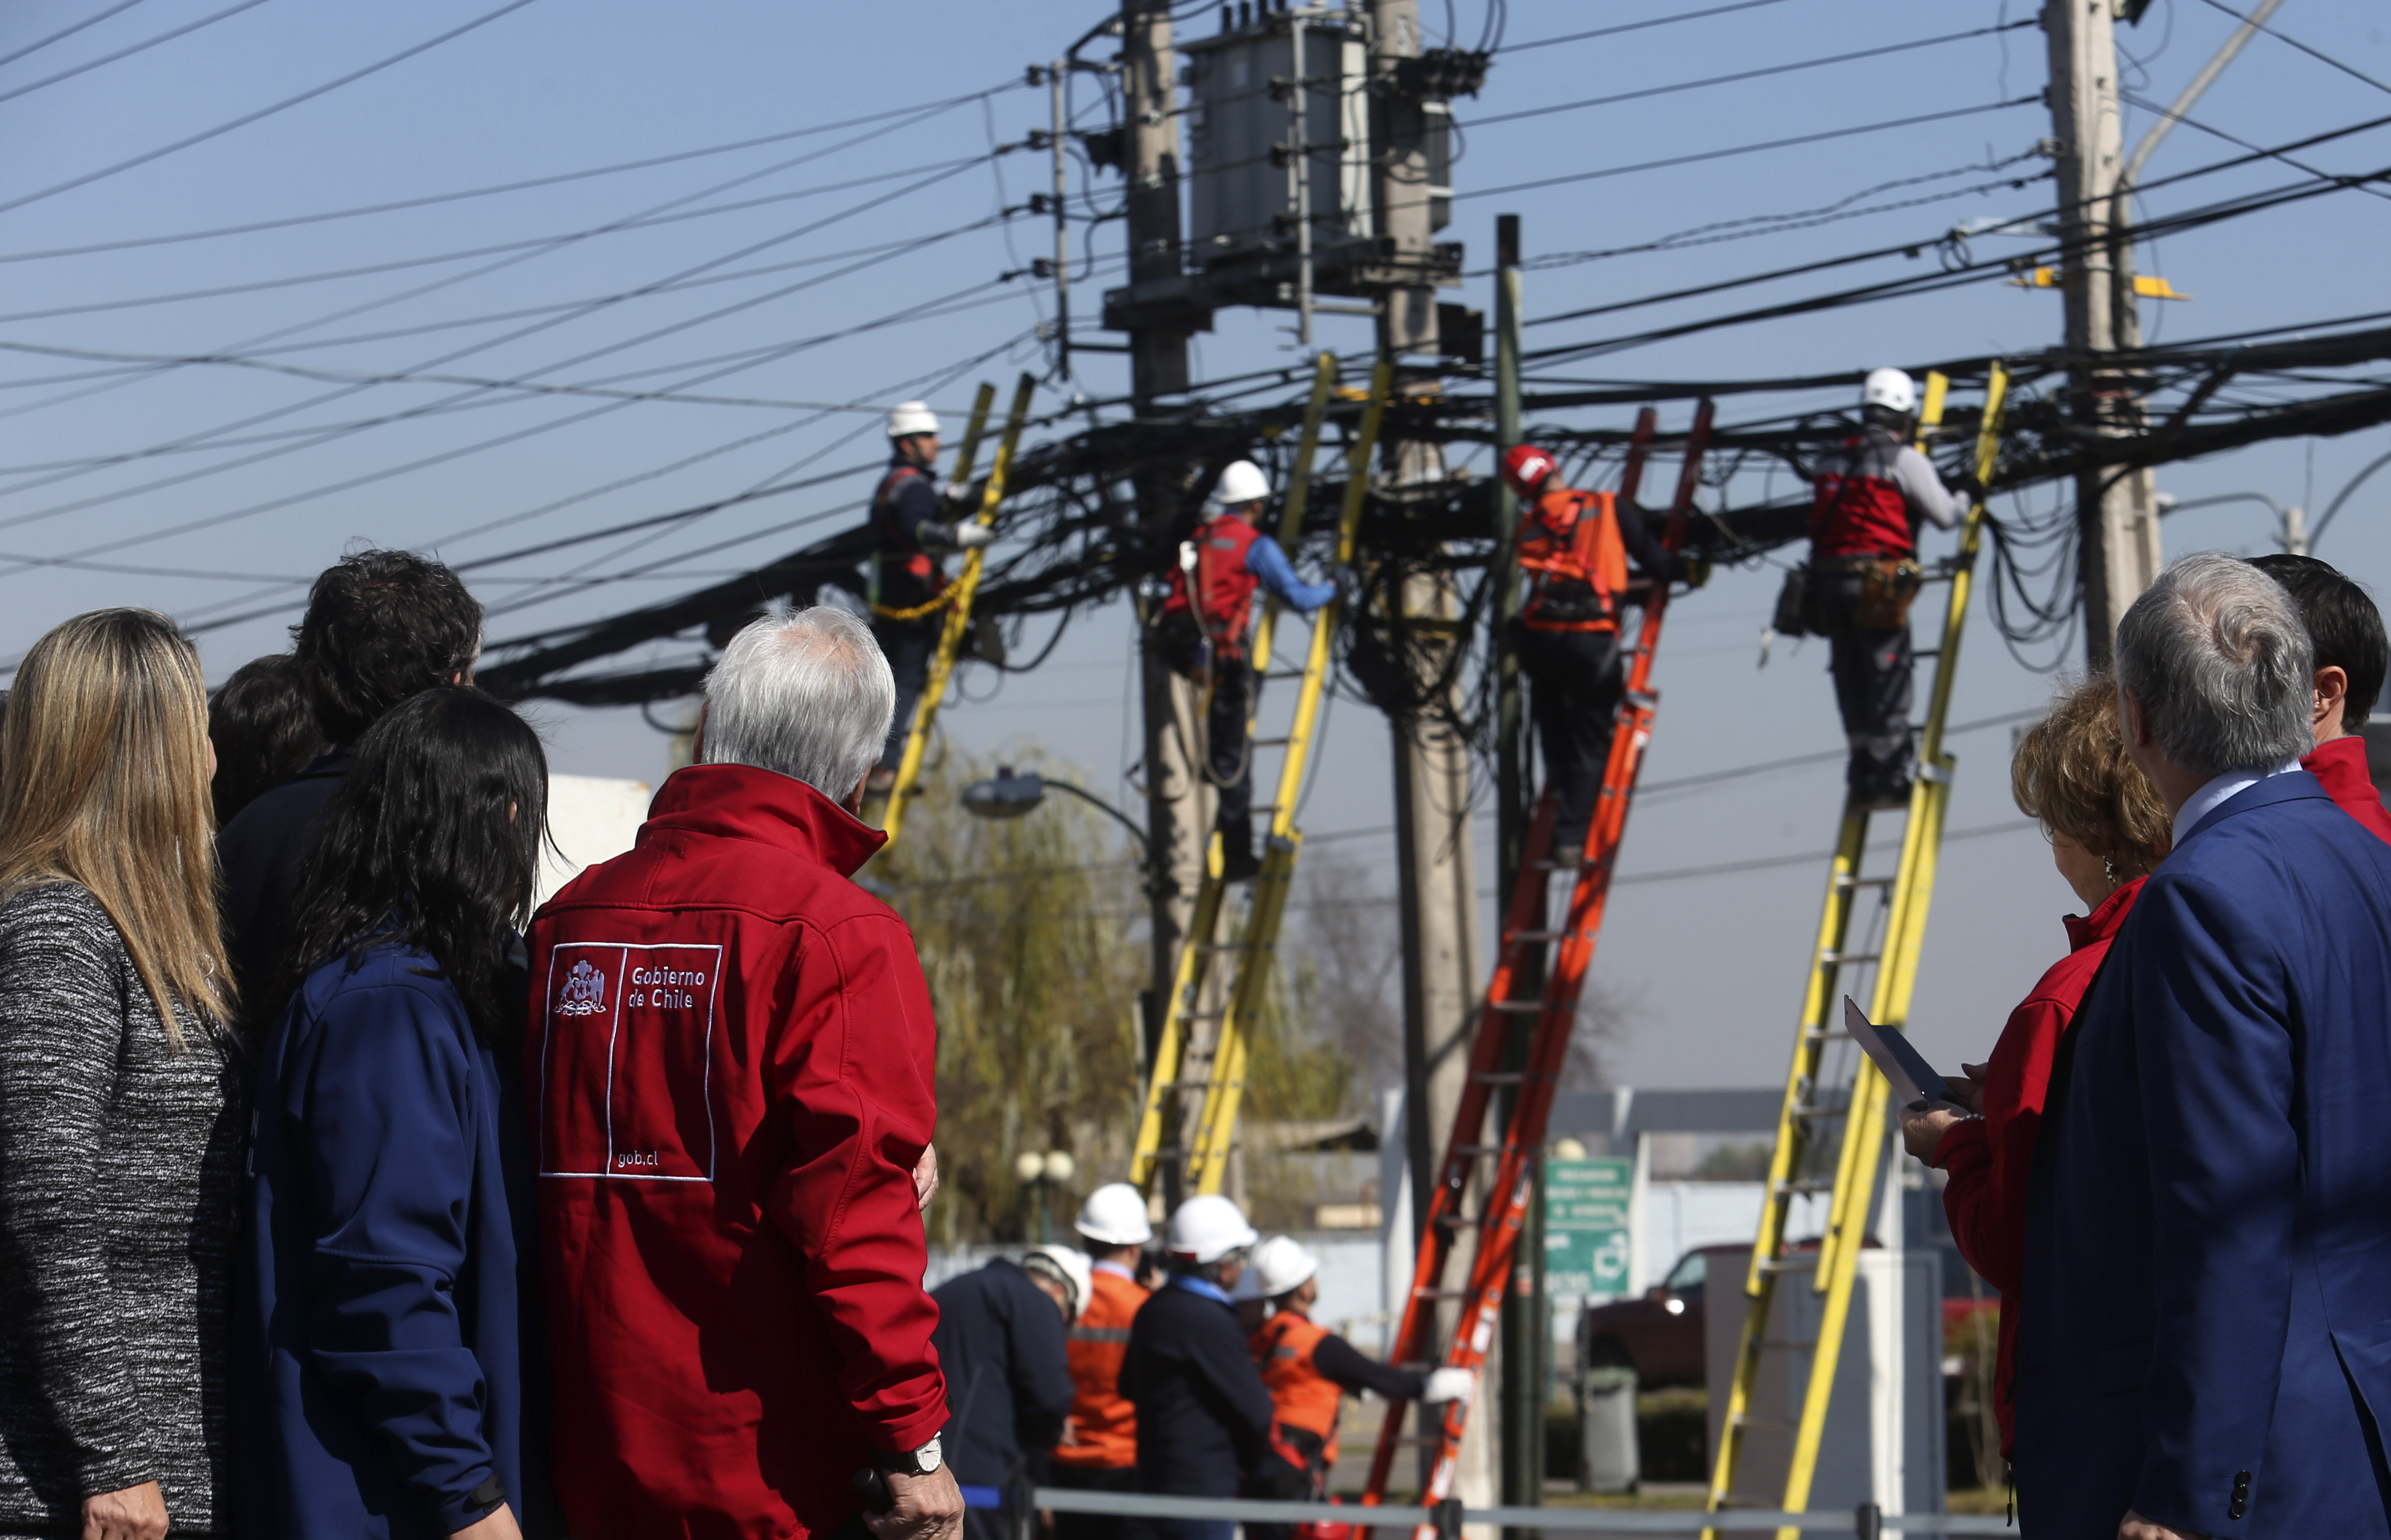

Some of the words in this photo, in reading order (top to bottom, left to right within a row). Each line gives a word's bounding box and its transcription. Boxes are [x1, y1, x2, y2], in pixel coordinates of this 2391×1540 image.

[632, 966, 705, 985] Gobierno
[628, 989, 645, 1008] de
[651, 989, 693, 1009] Chile
[618, 1150, 658, 1168] gob.cl
